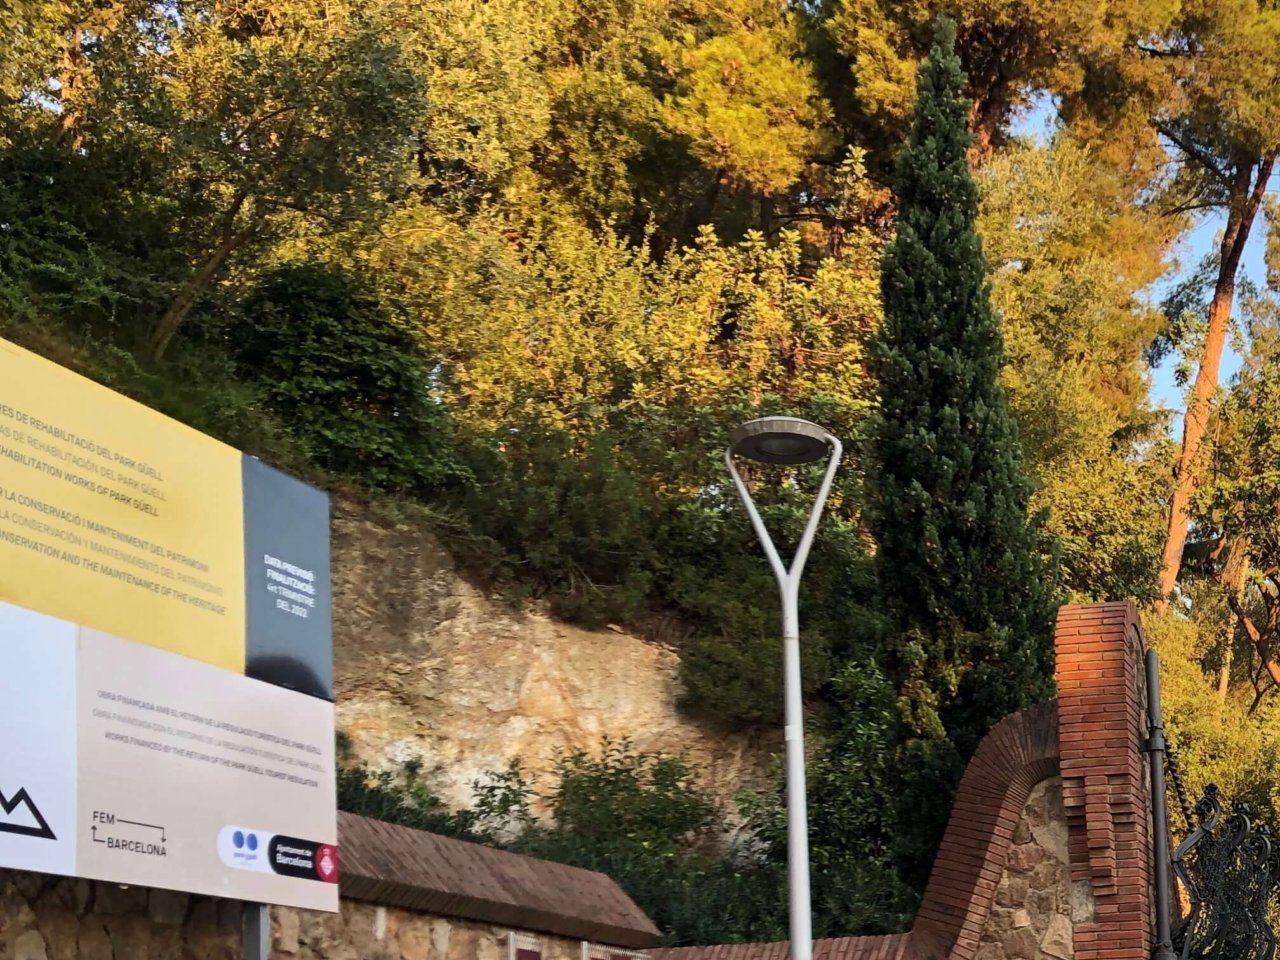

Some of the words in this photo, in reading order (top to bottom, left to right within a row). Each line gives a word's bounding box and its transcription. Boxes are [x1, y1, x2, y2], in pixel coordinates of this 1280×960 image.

[12, 430, 25, 444] DE
[26, 436, 99, 474] REHABILITACIÓN
[99, 466, 117, 481] DEL
[117, 473, 140, 490] PARK
[141, 483, 168, 502] GÜELL
[15, 411, 29, 425] DE
[29, 417, 96, 453] REHABILITACIÓ
[96, 445, 113, 461] DEL
[113, 453, 136, 470] PARK
[137, 462, 164, 482] GÜELL
[64, 471, 96, 493] WORKS
[96, 484, 110, 496] OF
[109, 489, 133, 507] PARK
[132, 499, 159, 517] GÜELL
[5, 489, 17, 502] LA
[17, 494, 81, 527] CONSERVACIÓ
[87, 519, 149, 550] MANTENIMENT
[150, 543, 166, 558] DEL
[12, 512, 82, 546] CONSERVACIÓN
[160, 566, 175, 580] DEL
[60, 551, 81, 566] AND
[81, 557, 100, 573] THE
[100, 564, 160, 594] MAINTENANCE
[160, 585, 173, 597] OF
[172, 589, 189, 603] THE
[92, 811, 115, 825] FEM
[106, 836, 167, 857] BARCELONA
[276, 853, 313, 869] Barcelona
